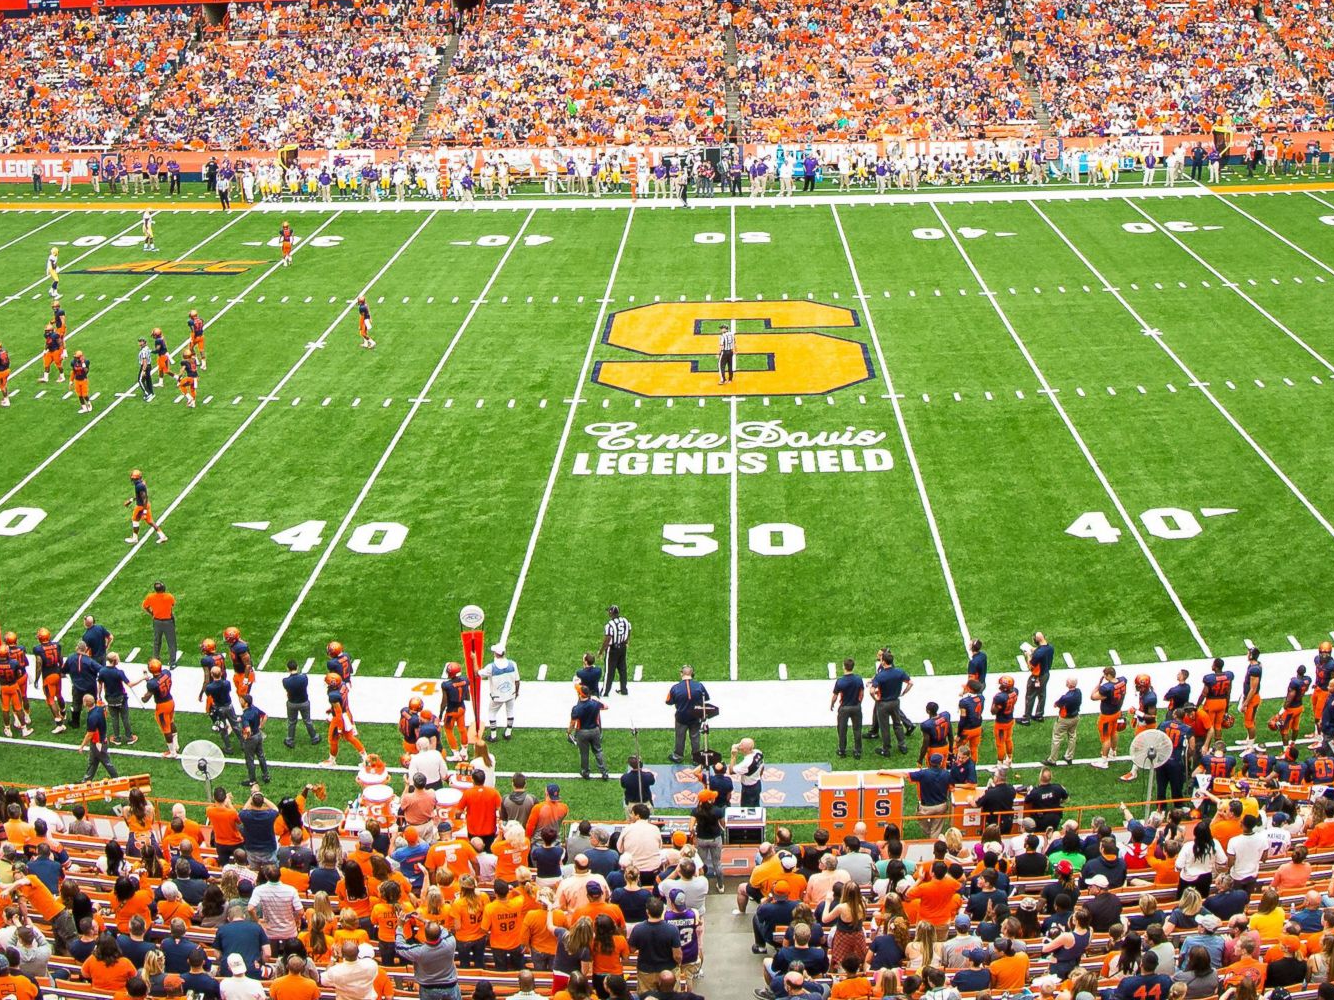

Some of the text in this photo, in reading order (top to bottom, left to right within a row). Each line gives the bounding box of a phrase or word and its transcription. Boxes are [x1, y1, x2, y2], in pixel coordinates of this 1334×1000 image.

[591, 299, 875, 398] S
[584, 418, 886, 451] Ernie Davis
[571, 448, 895, 476] LEGENDS FIELD
[1065, 507, 1206, 545] 40
[271, 520, 411, 556] 40
[661, 523, 807, 558] 50
[1314, 760, 1334, 778] 83
[371, 805, 381, 816] G
[439, 808, 449, 818] G
[831, 800, 848, 818] S
[875, 799, 891, 817] S
[1271, 842, 1283, 856] 7
[497, 912, 518, 920] DIXON
[499, 922, 516, 932] 92
[1133, 983, 1161, 1000] 44
